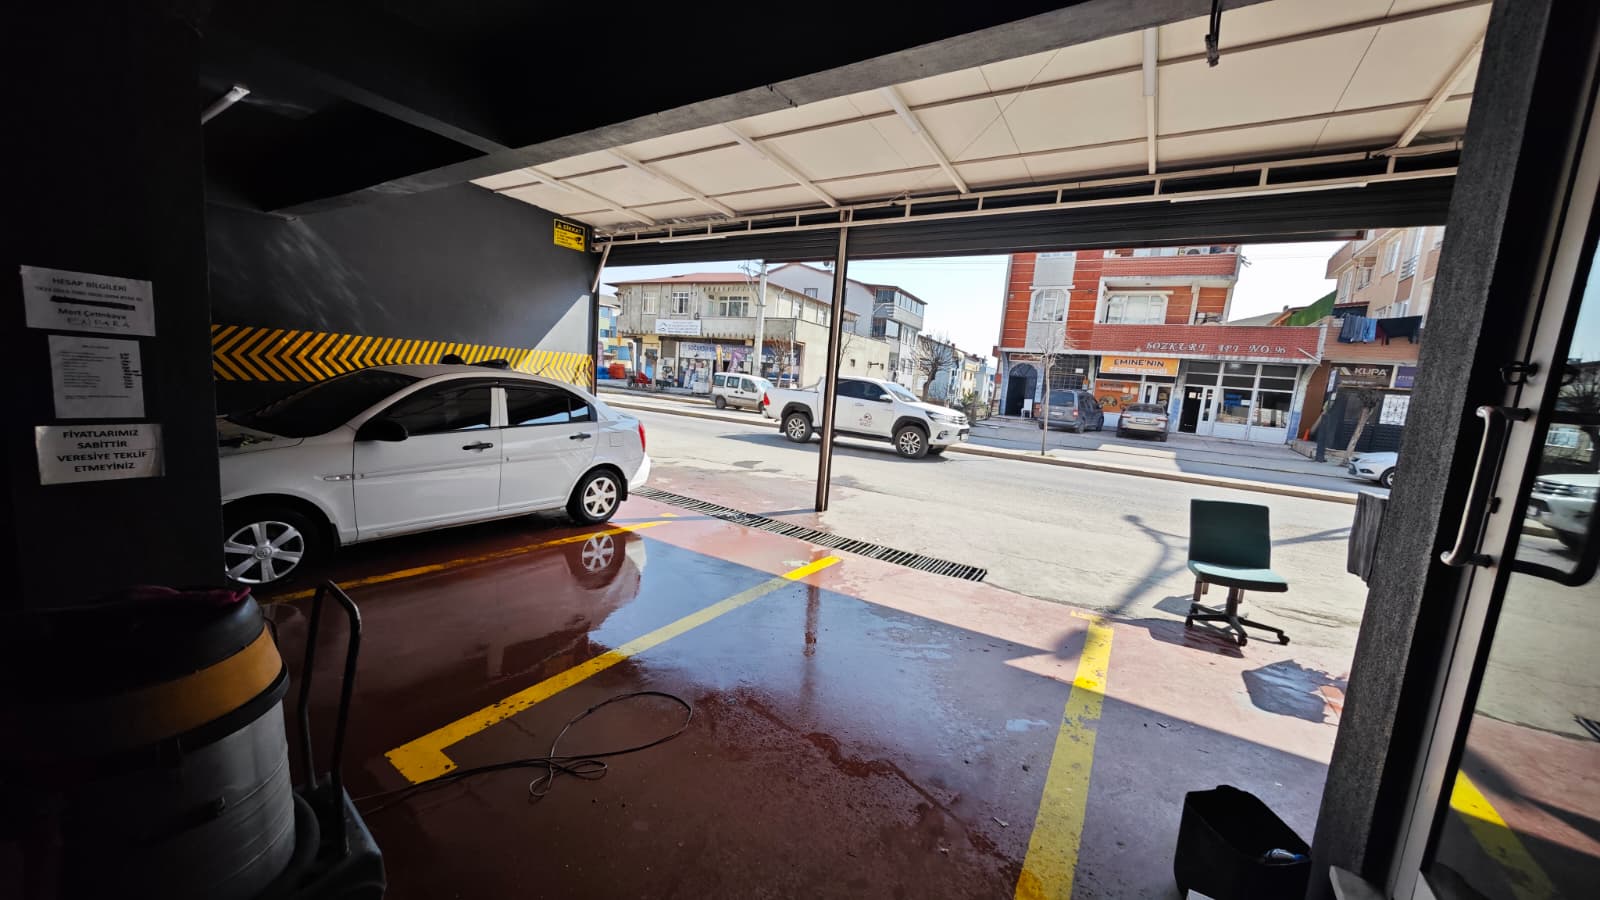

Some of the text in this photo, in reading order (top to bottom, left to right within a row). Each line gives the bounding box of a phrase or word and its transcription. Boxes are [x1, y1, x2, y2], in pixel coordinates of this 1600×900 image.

[52, 278, 127, 292] HESAP BİLGİLERİ
[1354, 367, 1387, 376] KUPA
[62, 429, 139, 438] FİYATLARIMIZ
[77, 440, 128, 449] SABİTTİR
[57, 450, 148, 462] VERESİYE TEKLİF
[74, 462, 136, 472] ETMEYİNİZ
